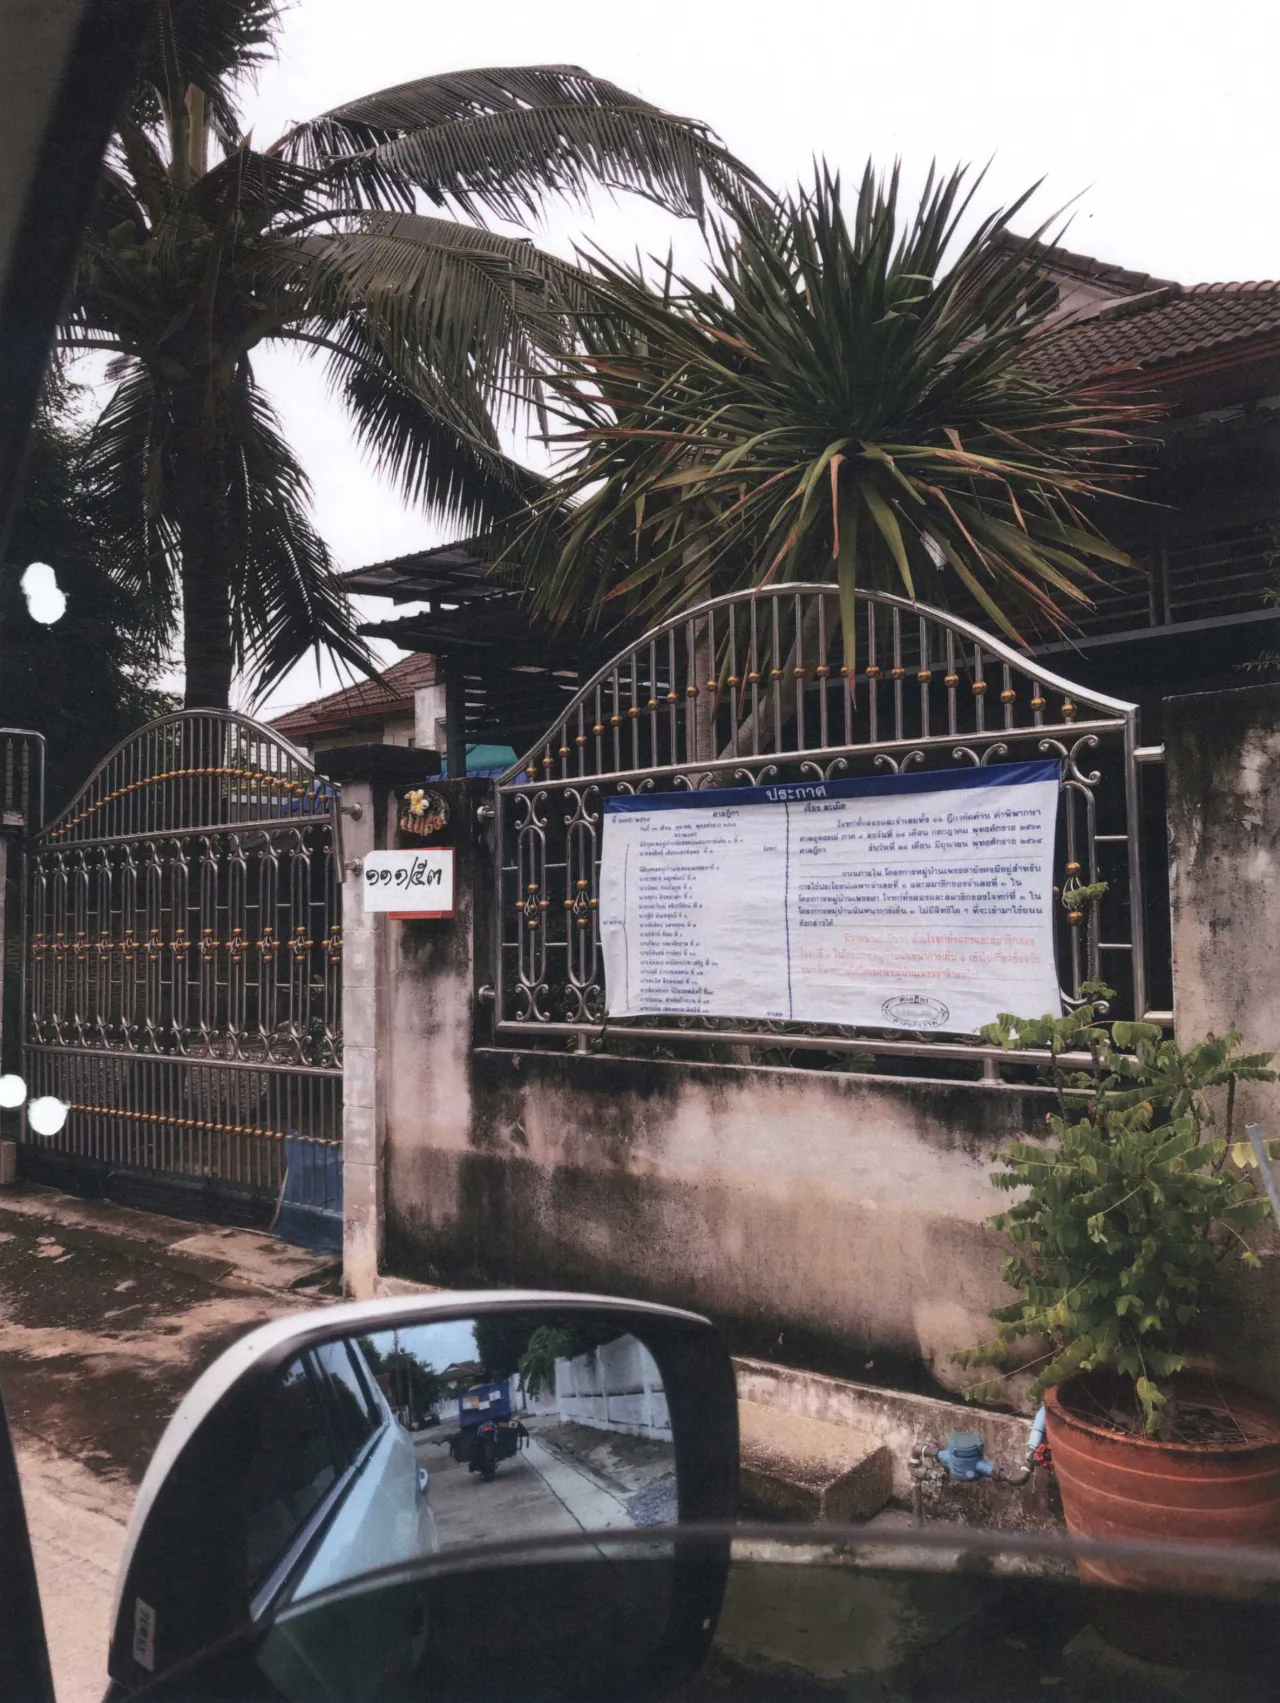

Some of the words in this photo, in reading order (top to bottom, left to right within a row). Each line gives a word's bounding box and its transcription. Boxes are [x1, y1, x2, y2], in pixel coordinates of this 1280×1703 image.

[766, 785, 826, 800] ประกาศ
[712, 809, 740, 819] ศาลฎีกา
[366, 857, 442, 890] ๑๑๑/๕๓
